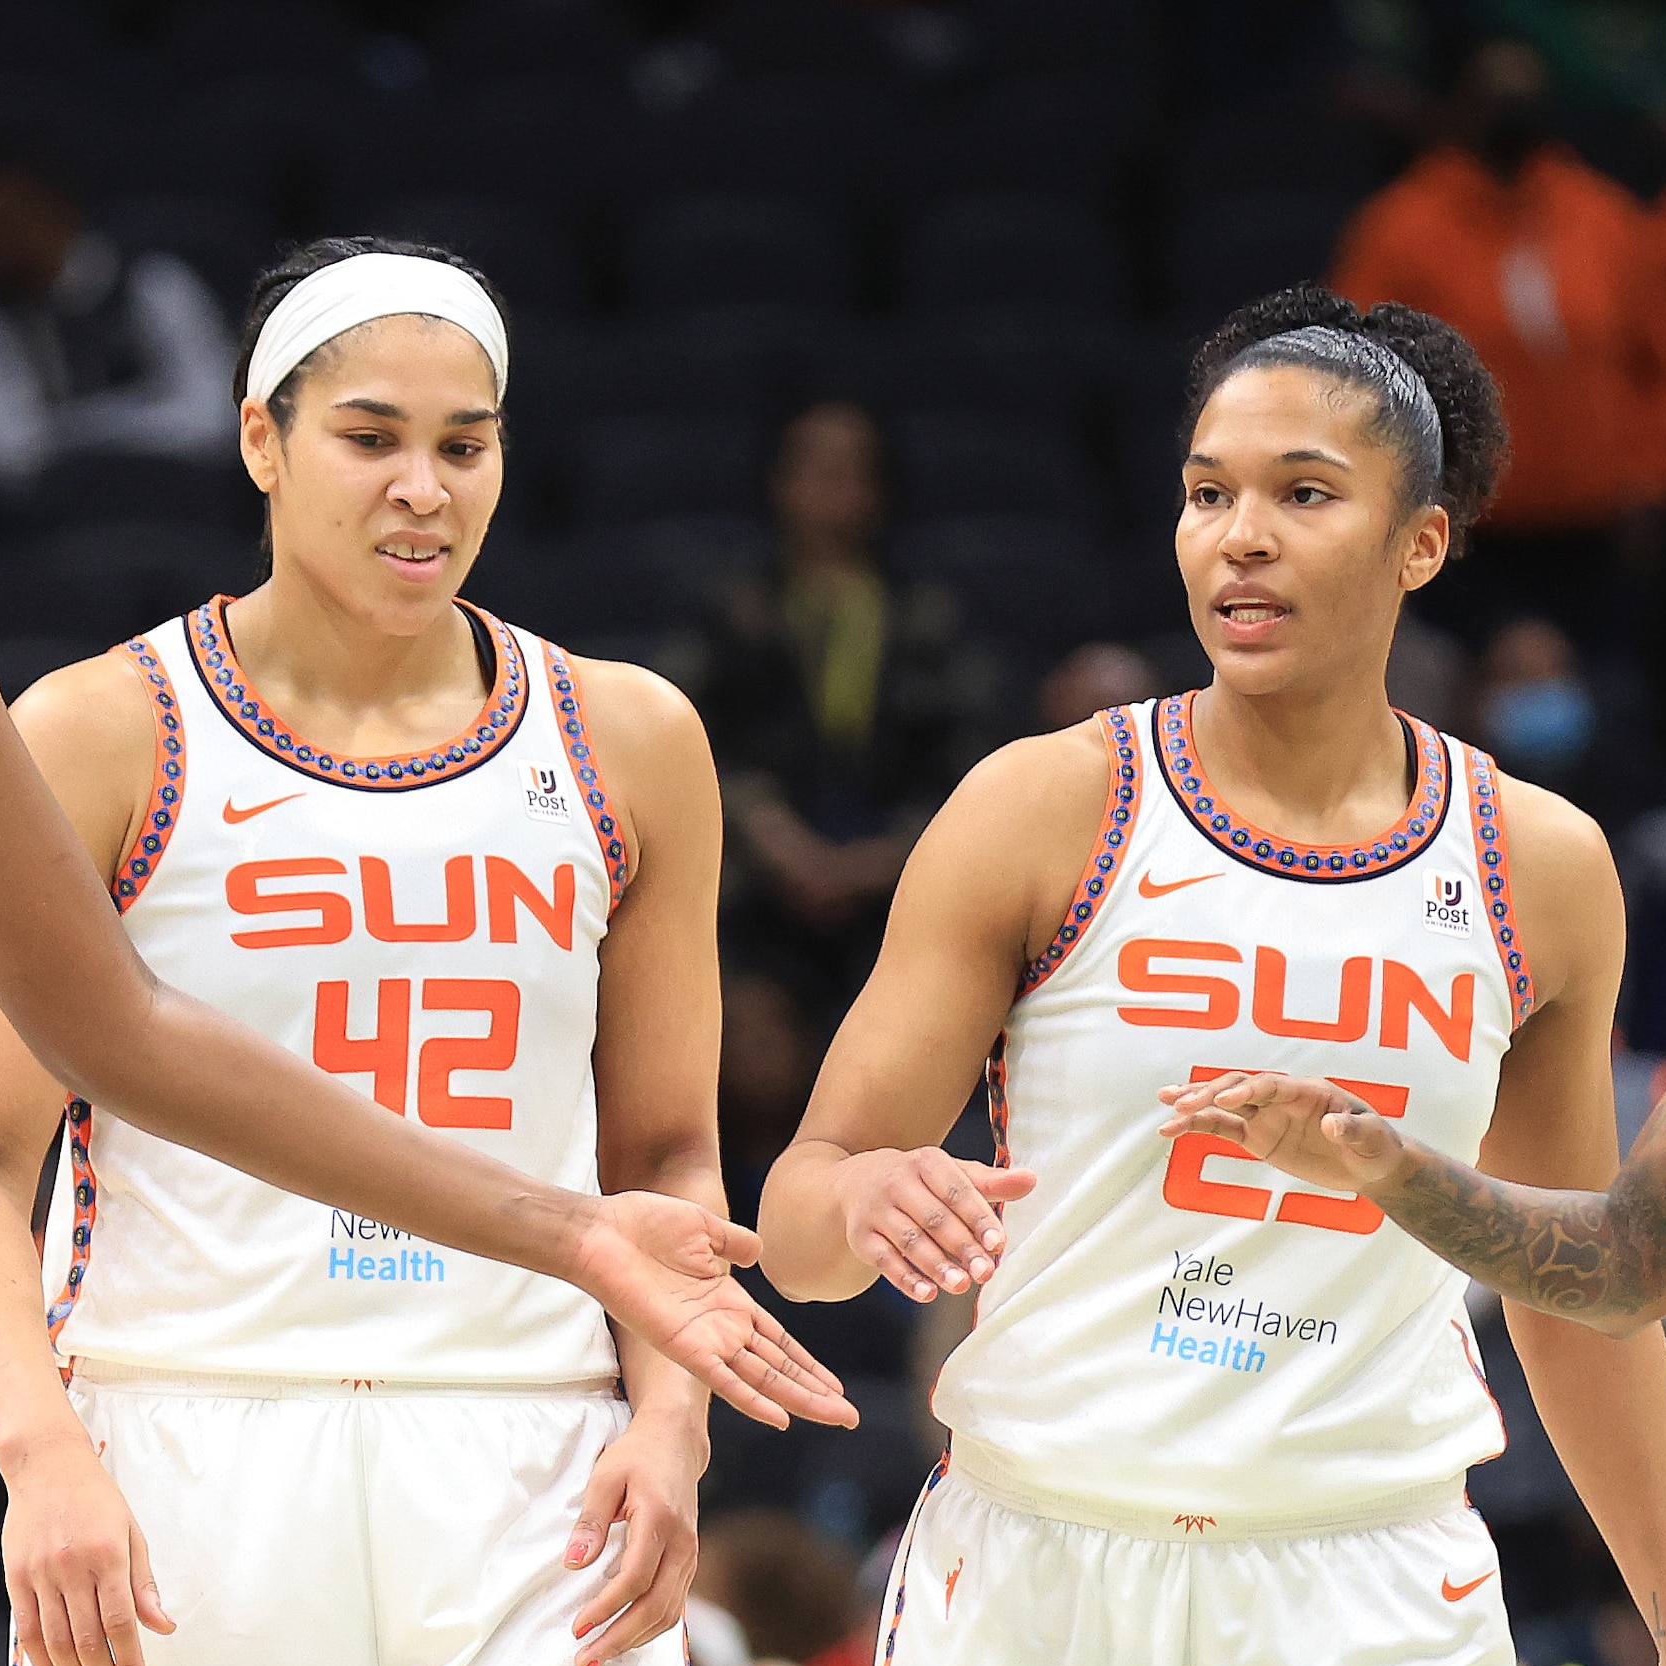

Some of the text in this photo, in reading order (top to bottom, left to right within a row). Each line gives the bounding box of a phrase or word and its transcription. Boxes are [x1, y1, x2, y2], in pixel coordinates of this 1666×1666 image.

[526, 789, 568, 812] Post
[225, 854, 575, 952] SUN
[1425, 900, 1470, 925] Post
[1117, 938, 1475, 1063] SUN
[312, 978, 521, 1131] 42
[328, 1246, 445, 1282] Health
[1173, 1250, 1233, 1286] Yale
[1158, 1286, 1338, 1345] NewHaven
[1150, 1322, 1267, 1373] Health
